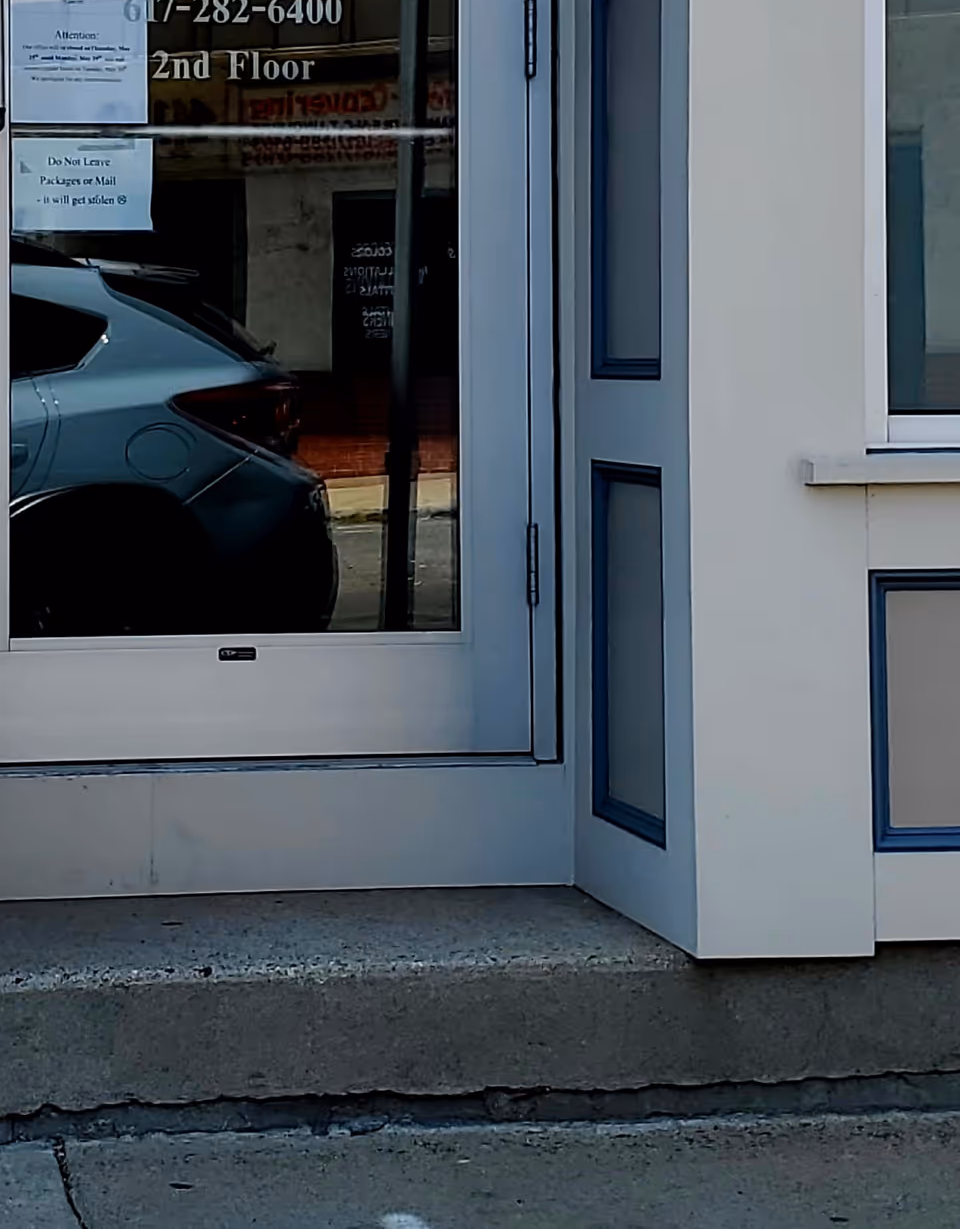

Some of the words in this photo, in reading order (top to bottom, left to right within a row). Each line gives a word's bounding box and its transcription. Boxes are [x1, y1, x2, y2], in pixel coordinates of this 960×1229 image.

[55, 29, 99, 40] Attention:
[151, 50, 211, 81] 2nd
[227, 51, 316, 81] Floor
[48, 156, 62, 167] Do
[64, 156, 81, 167] Not
[83, 156, 111, 168] Leave
[40, 175, 81, 188] Packages
[83, 177, 93, 186] or
[95, 176, 117, 187] Mail
[52, 195, 70, 206] will
[72, 195, 86, 207] get
[88, 194, 115, 206] stolen
